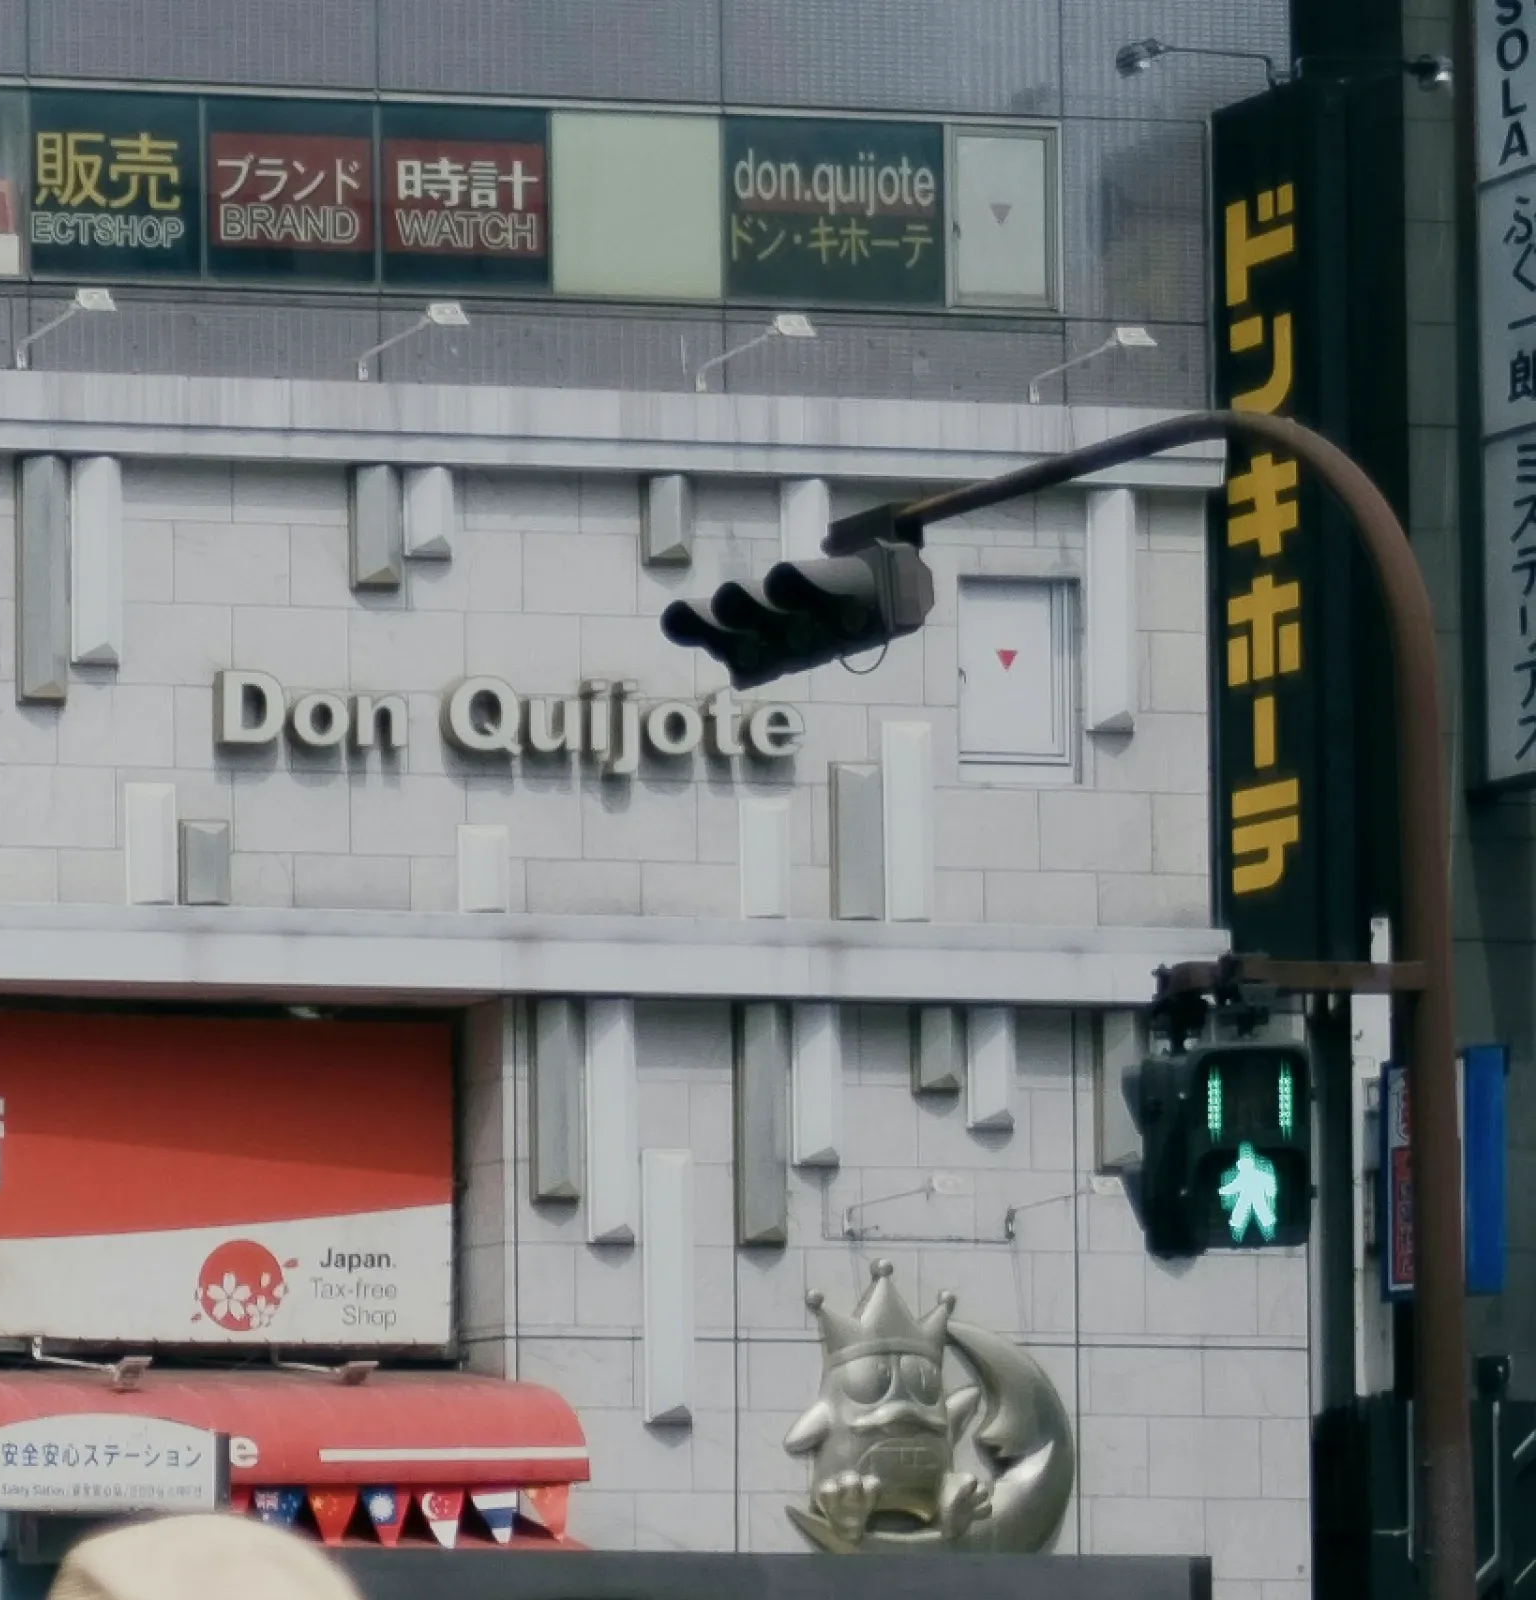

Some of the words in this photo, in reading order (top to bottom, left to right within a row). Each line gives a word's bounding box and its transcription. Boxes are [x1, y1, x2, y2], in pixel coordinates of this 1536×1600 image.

[34, 131, 181, 211] 販売
[215, 154, 360, 203] ブランド
[396, 157, 539, 210] 時計
[219, 204, 360, 244] BRAND
[395, 210, 537, 251] WATCH
[213, 668, 409, 750] Don
[440, 674, 805, 775] Quijote
[309, 1277, 398, 1303] Tax-free
[341, 1304, 398, 1331] Shop
[0, 1441, 204, 1469] 安全安心ステーション
